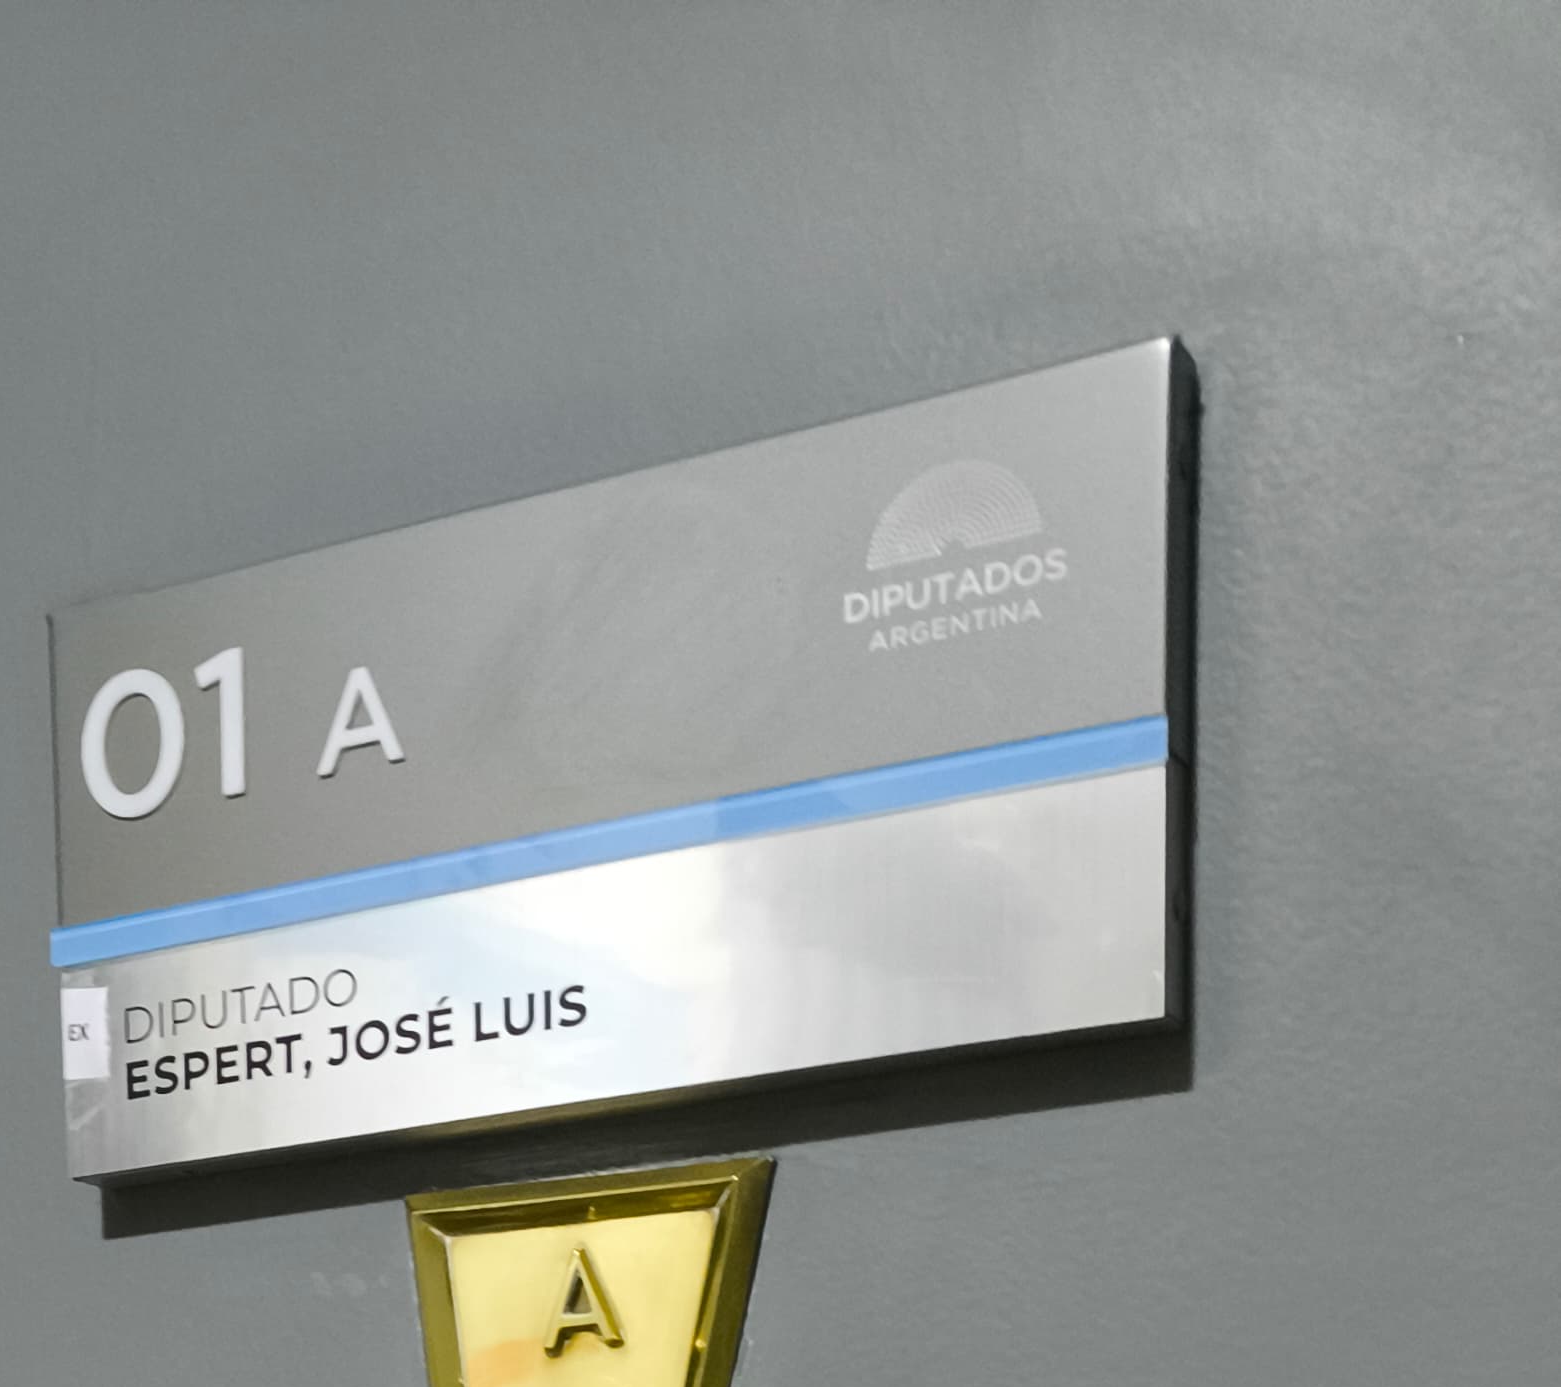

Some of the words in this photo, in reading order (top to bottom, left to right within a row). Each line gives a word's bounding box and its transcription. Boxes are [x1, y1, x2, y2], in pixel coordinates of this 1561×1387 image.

[843, 547, 1067, 624] DIPUTADOS
[868, 599, 1042, 654] ARGENTINA
[80, 647, 246, 820] 01
[316, 666, 406, 778] A
[67, 1023, 90, 1041] EX
[124, 968, 359, 1044] DIPUTADO
[126, 1033, 313, 1100] ESPERT,
[327, 996, 454, 1066] JOSÉ
[474, 984, 589, 1042] LUIS
[543, 1247, 625, 1359] A
